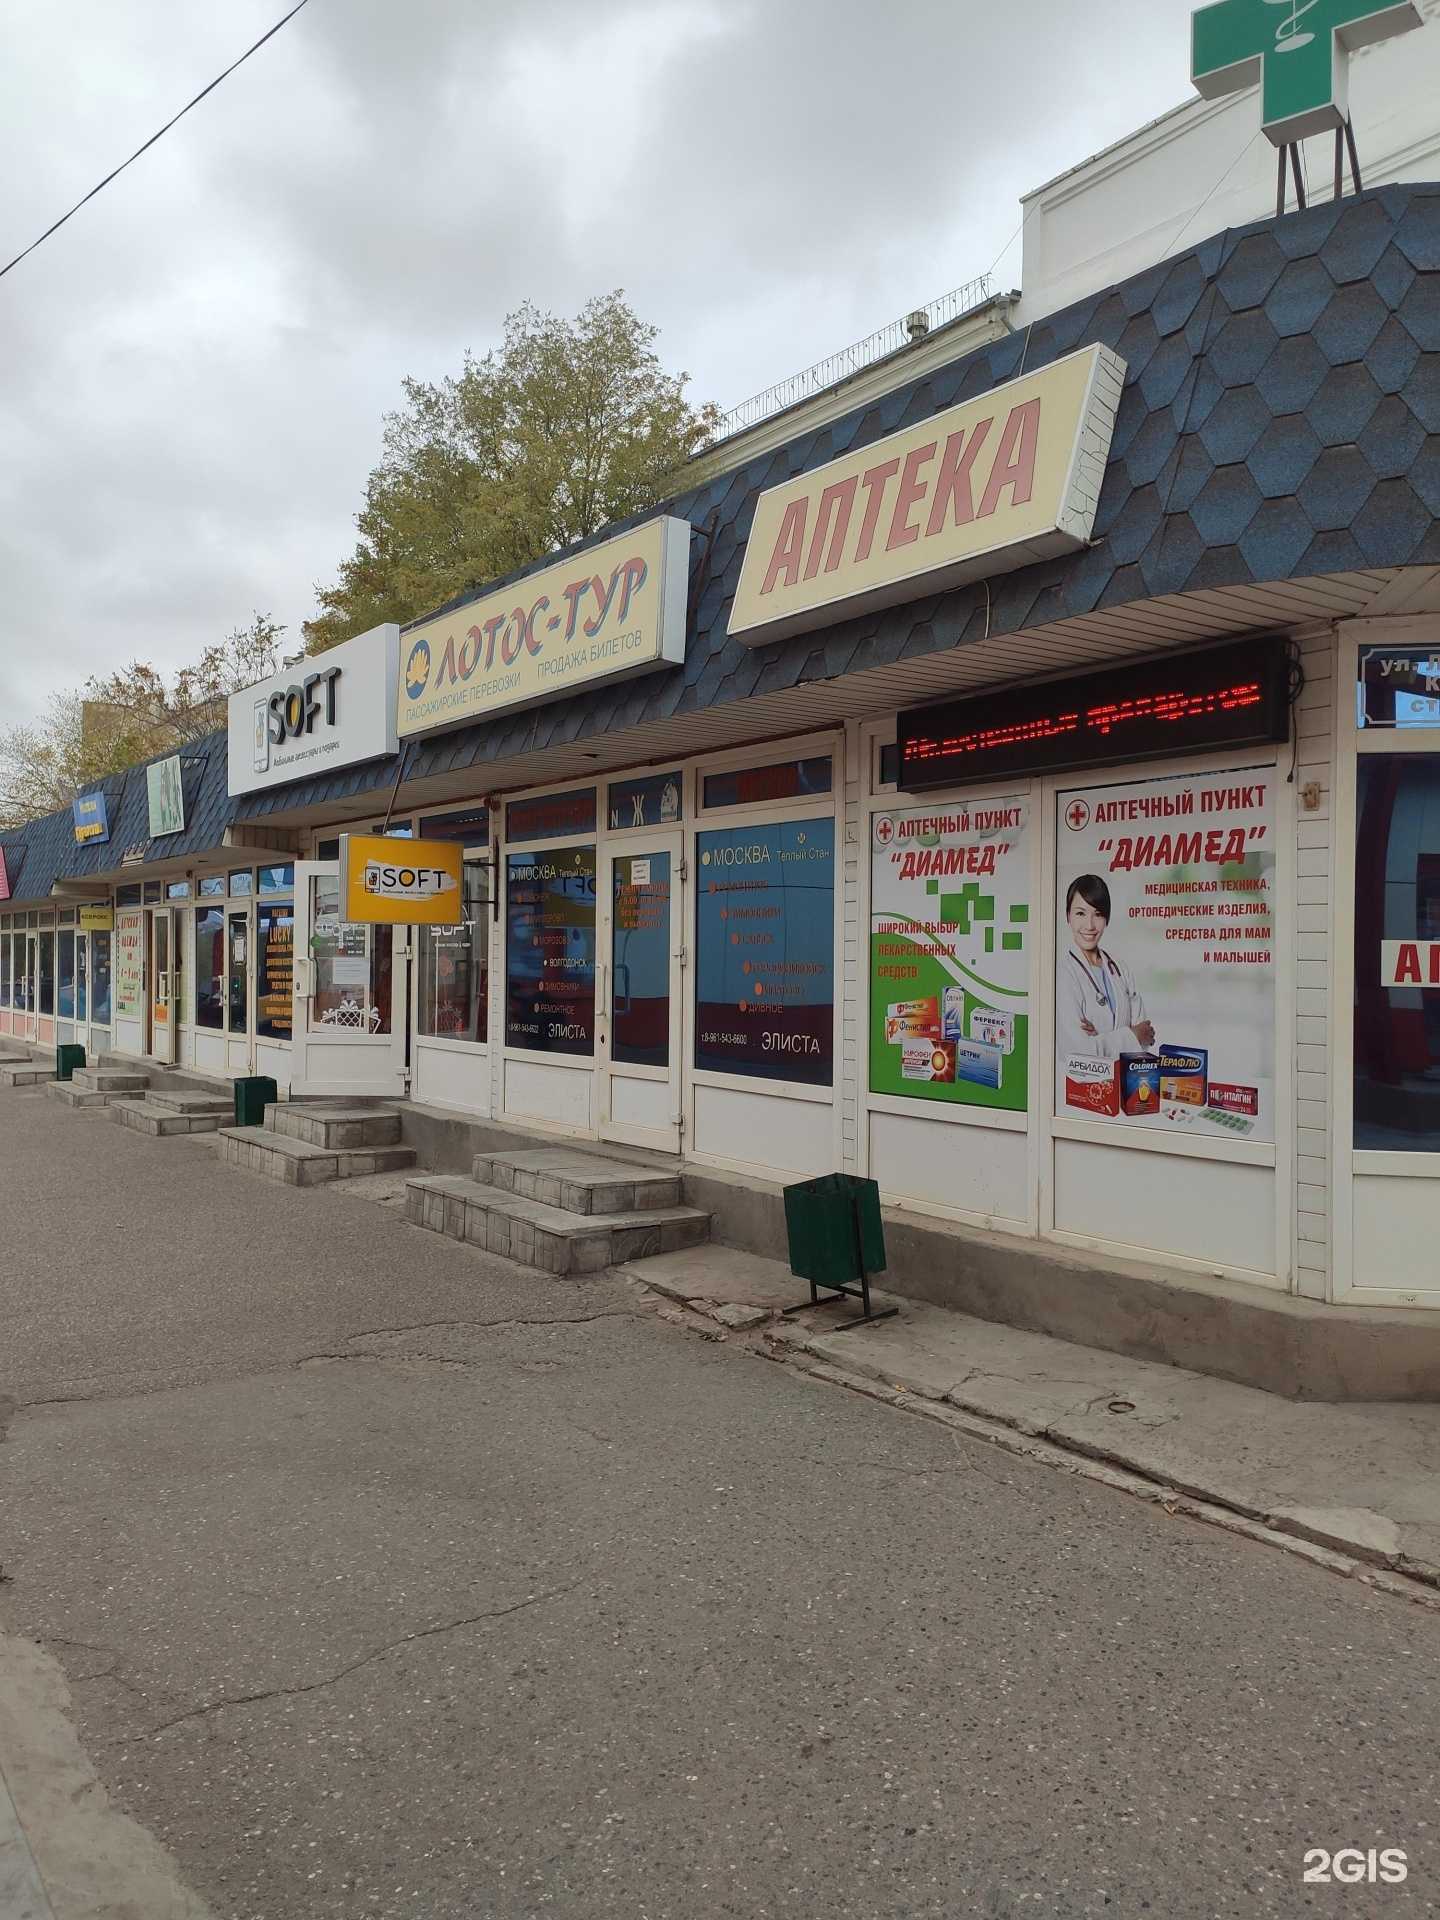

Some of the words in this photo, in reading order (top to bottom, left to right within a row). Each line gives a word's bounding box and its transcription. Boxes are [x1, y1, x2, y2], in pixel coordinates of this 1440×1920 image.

[760, 397, 1040, 595] АПТЕКА
[434, 556, 648, 689] ЛОТОС-ТУР
[406, 689, 469, 721] ПАССАЖИРСКИЕ
[470, 672, 521, 703] ПЕРЕВОЗКИ
[537, 651, 588, 680] ПРОДАЖА
[590, 629, 642, 660] БИЛЕТОВ
[1380, 658, 1418, 677] ул.
[268, 666, 342, 744] SOFT
[1095, 789, 1193, 823] АПТЕЧНЫЙ
[1200, 785, 1266, 812] ПУНКТ
[898, 809, 970, 838] АПТЕЧНЫЙ
[975, 808, 1022, 830] ПУНКТ
[714, 845, 771, 866] МОСКВА
[776, 849, 806, 862] Теплый
[809, 847, 830, 860] Стан
[1098, 826, 1267, 872] “ДИАМЕД”
[890, 843, 1010, 881] “ДИАМЕД”
[381, 868, 447, 889] SOFT
[518, 864, 557, 880] МОСКВА
[1145, 881, 1217, 896] МЕДИЦИНСКАЯ
[1220, 878, 1270, 892] ТЕХНИКА,
[1129, 904, 1214, 919] ОРТОПЕДИЧЕСКИЕ
[1218, 902, 1270, 917] ИЗДЕЛИЯ,
[270, 926, 291, 943] LUCKY
[878, 919, 922, 935] ШИРОКИЙ
[925, 922, 959, 934] ВЫБОР
[1165, 929, 1216, 942] СРЕДСТВА
[1219, 928, 1241, 942] ДЛЯ
[1245, 927, 1270, 939] МАМ
[878, 943, 956, 957] ЛЕКАРСТВЕННЫХ
[1204, 953, 1210, 963] И
[1213, 949, 1270, 963] МАЛЫШЕЙ
[878, 965, 918, 979] СРЕДСТВ
[748, 1002, 784, 1014] ДИВНОЕ
[973, 1015, 1006, 1026] ФЕРВЕКС
[548, 1022, 587, 1039] ЭЛИСТА
[761, 1031, 820, 1053] ЭЛИСТА
[1068, 1059, 1111, 1075] АРБИДОЛ
[1160, 1054, 1201, 1069] ТЕРАФЛЮ
